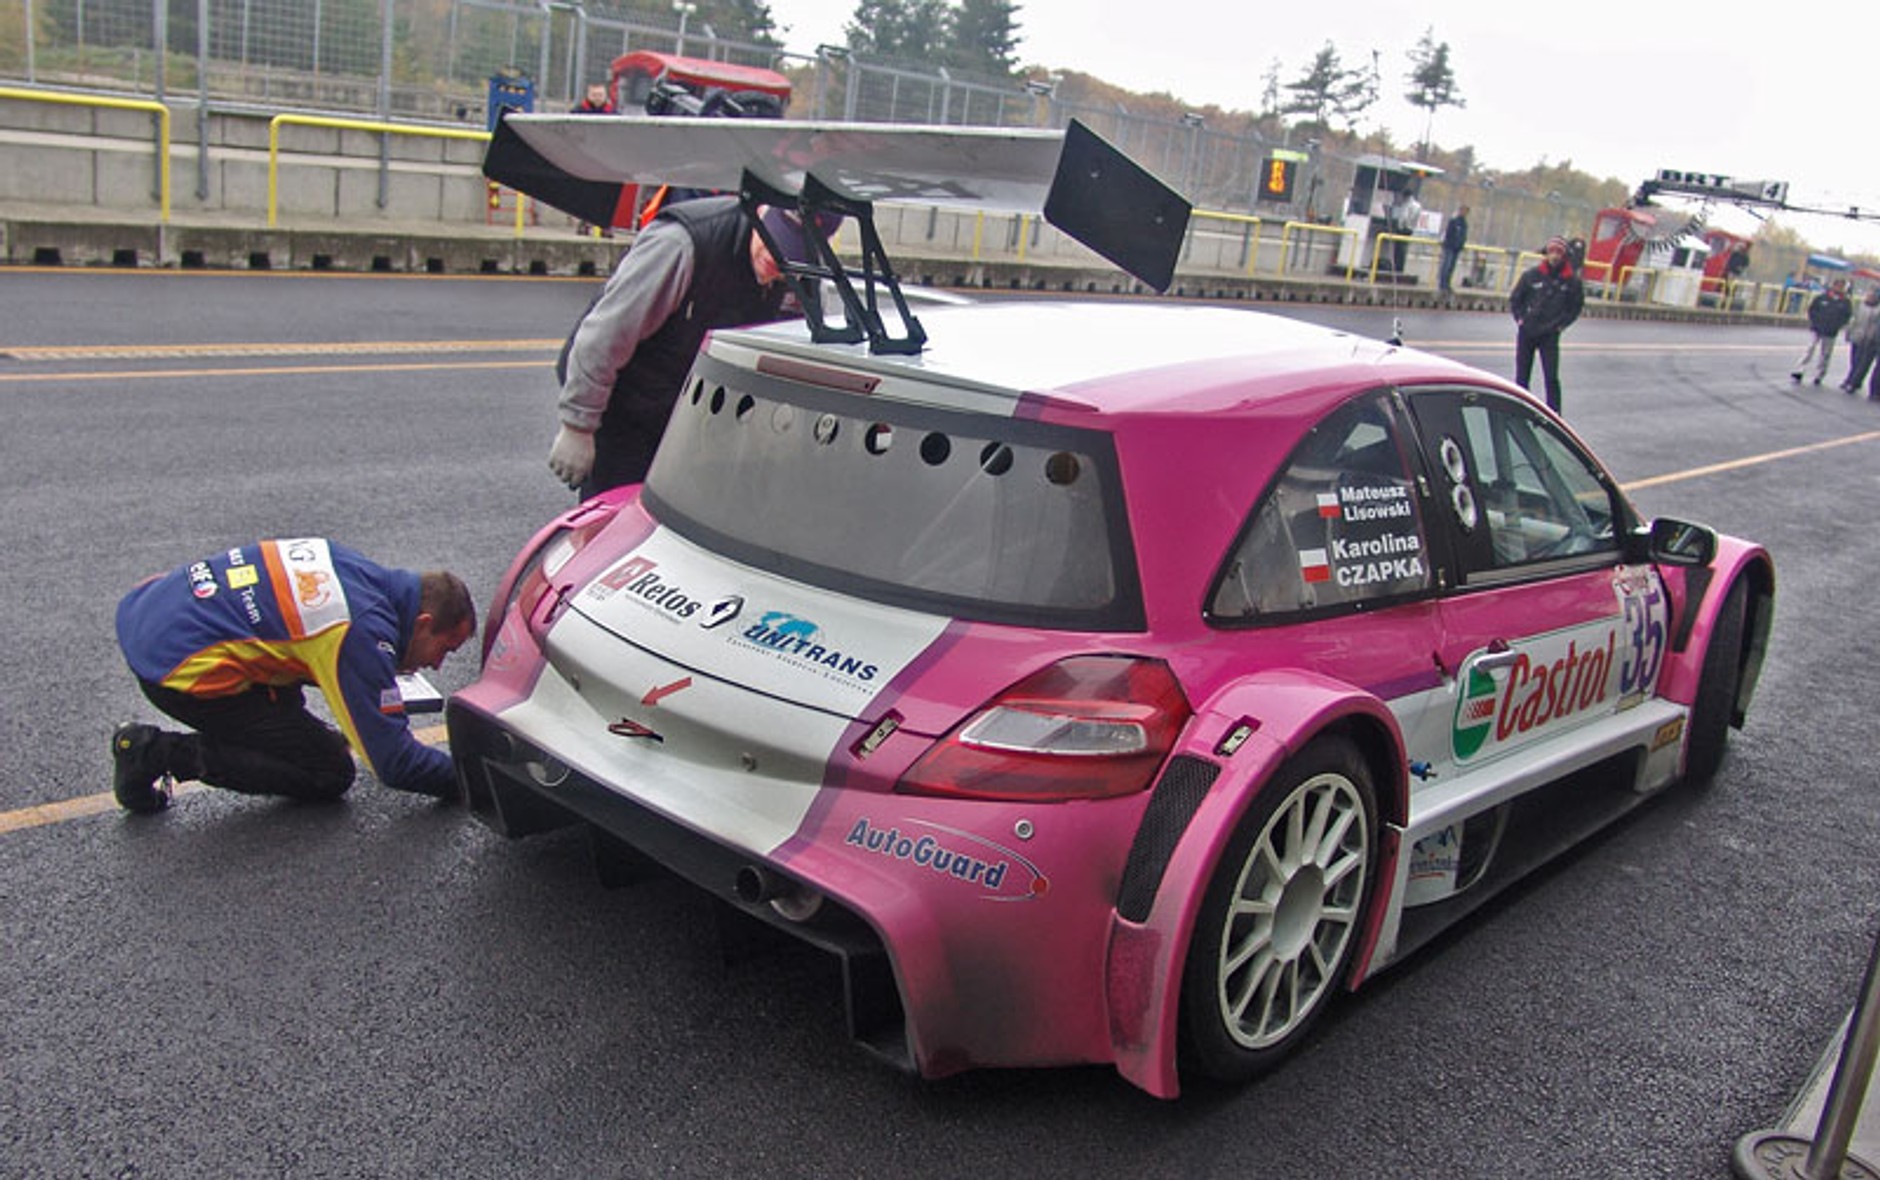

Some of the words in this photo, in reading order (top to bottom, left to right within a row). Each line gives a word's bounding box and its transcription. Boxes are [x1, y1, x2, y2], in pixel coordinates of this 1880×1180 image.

[1341, 486, 1407, 502] Mateusz
[1343, 500, 1412, 522] Lisowski
[1332, 532, 1421, 560] Karolina
[1336, 557, 1424, 587] CZAPKA
[241, 586, 261, 624] Team
[627, 571, 702, 618] Retos
[743, 624, 879, 681] UNITRANS
[1621, 591, 1663, 693] 35
[1496, 630, 1616, 742] Castrol
[846, 817, 1008, 889] AutoGuard
